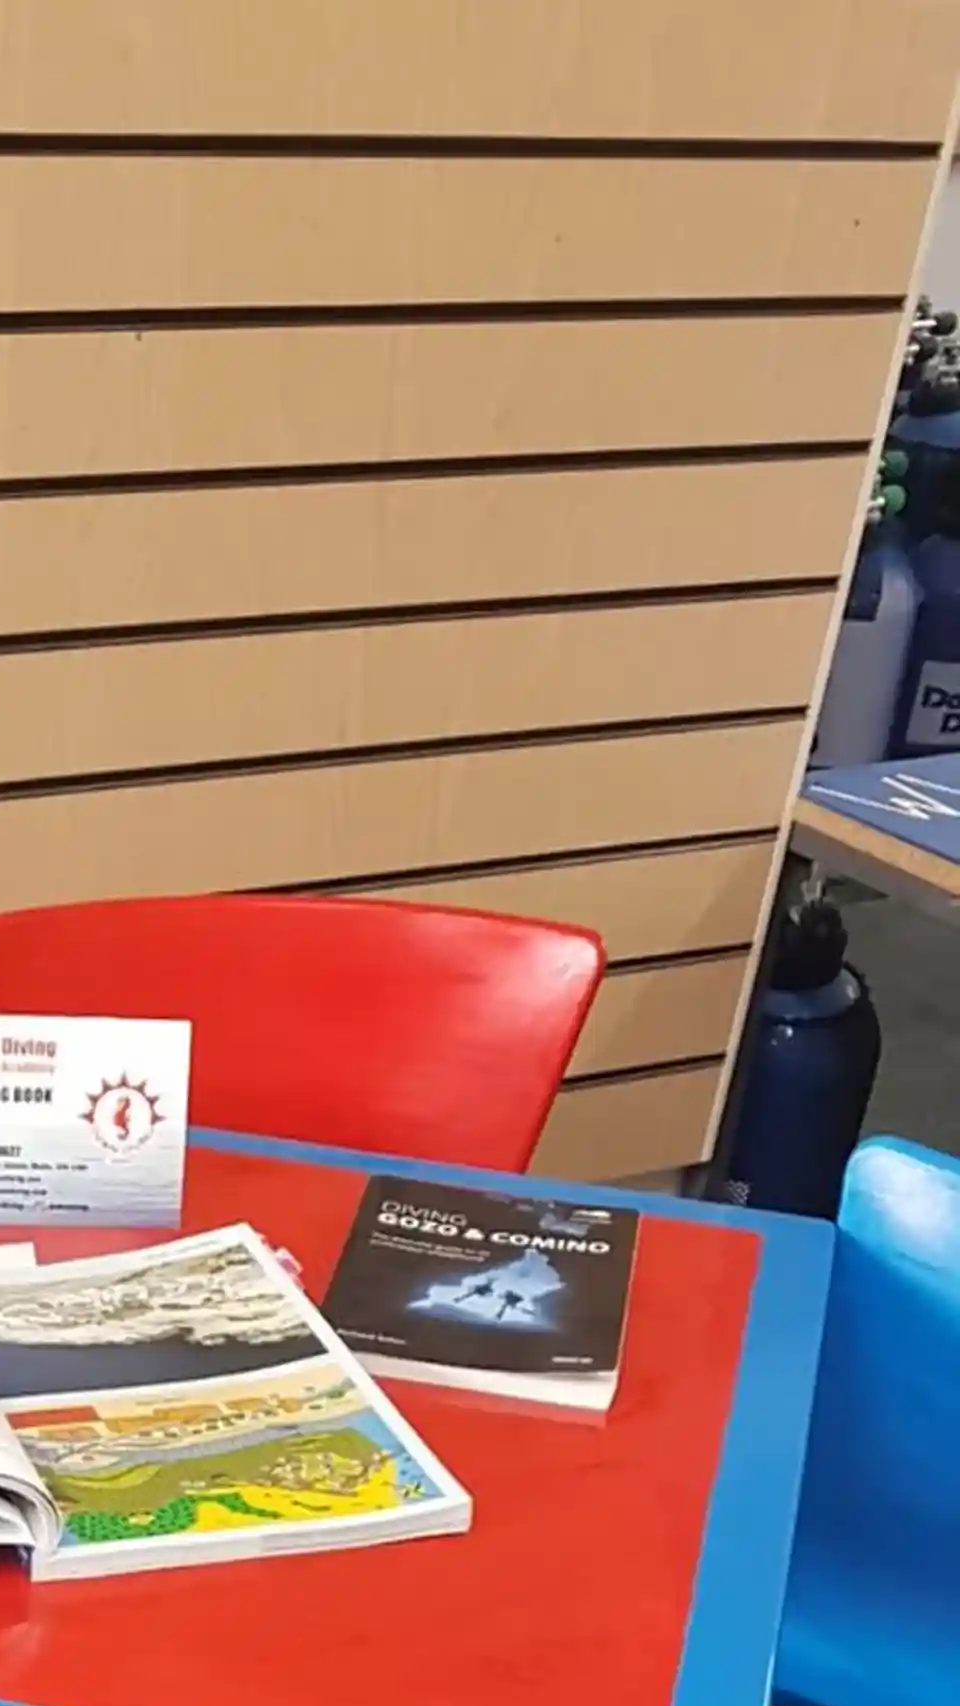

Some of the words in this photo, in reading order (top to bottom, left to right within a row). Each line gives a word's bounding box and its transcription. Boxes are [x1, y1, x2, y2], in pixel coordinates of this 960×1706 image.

[1, 1036, 56, 1058] Diving
[13, 1086, 53, 1105] BOOK
[381, 1200, 468, 1227] DIVING
[377, 1212, 458, 1237] GOZO
[463, 1227, 486, 1242] &
[491, 1231, 611, 1254] COMINO
